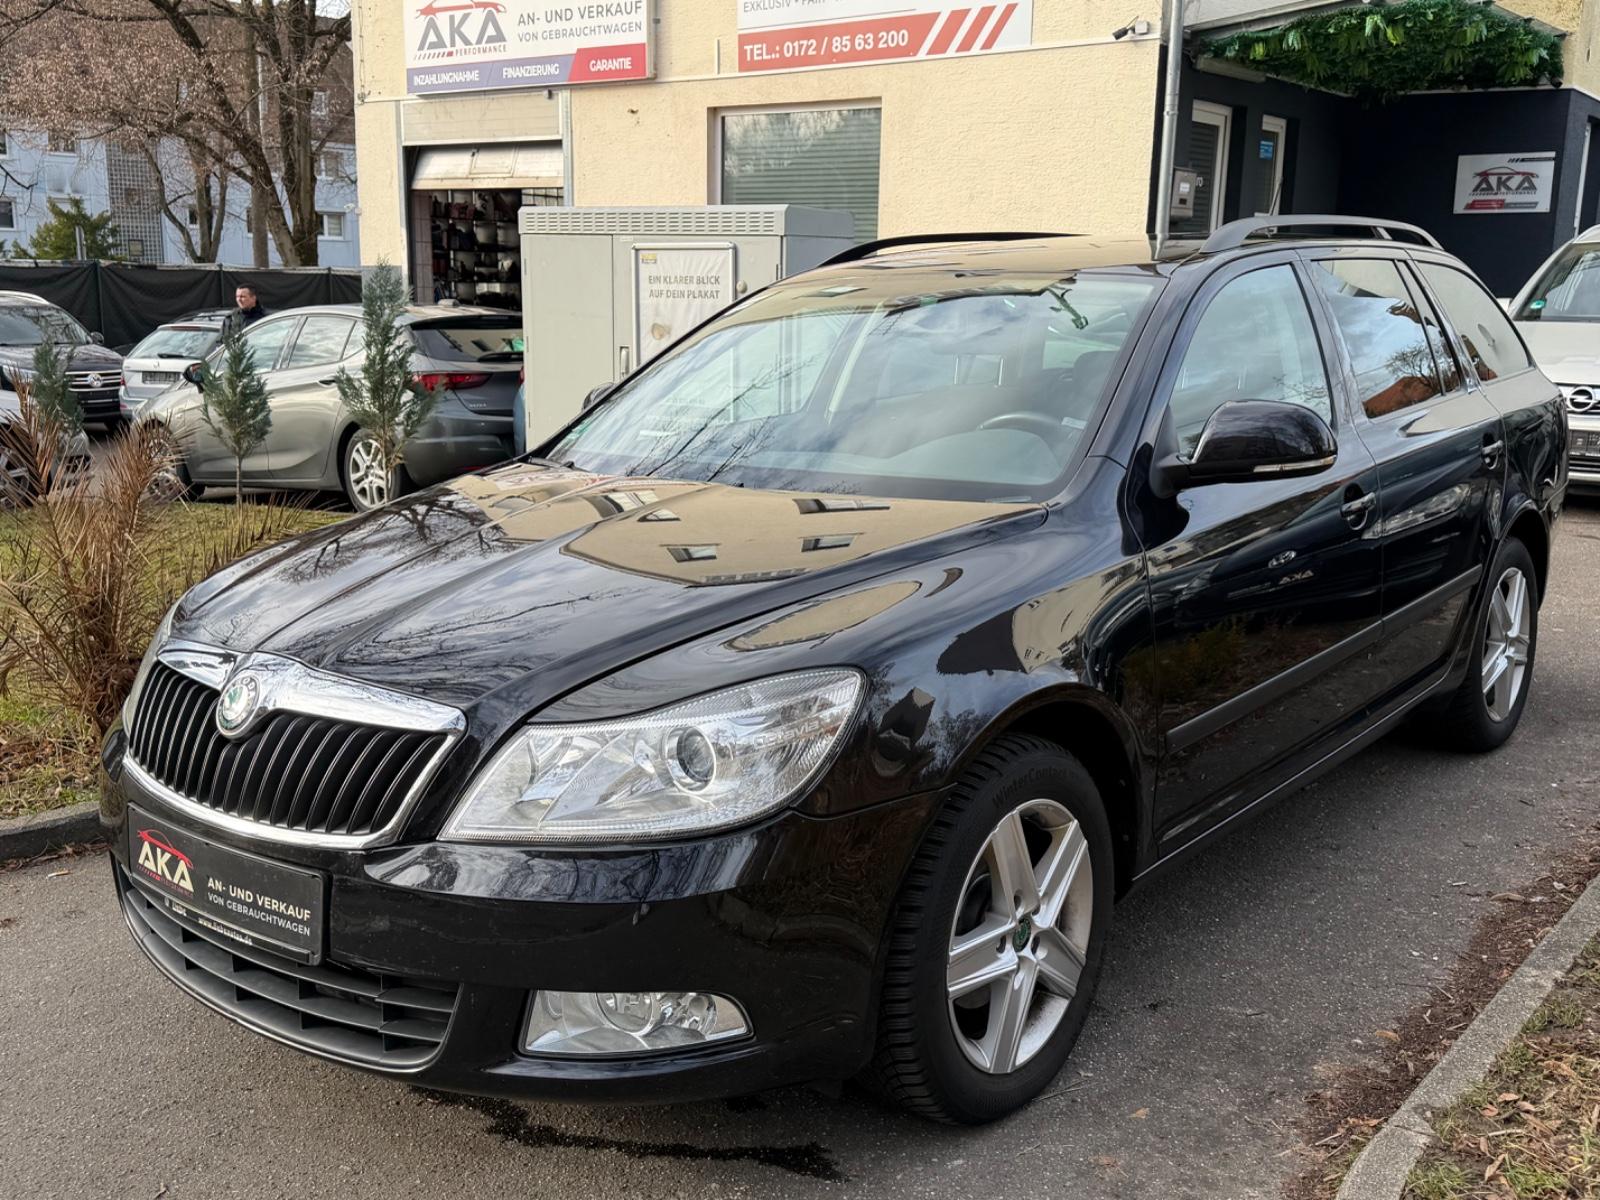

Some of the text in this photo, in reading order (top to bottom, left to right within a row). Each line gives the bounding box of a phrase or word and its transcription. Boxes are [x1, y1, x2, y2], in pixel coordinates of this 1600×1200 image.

[517, 0, 642, 26] AN- UND VERKAUF
[418, 10, 507, 51] AKA
[517, 21, 642, 42] VON GEBRAUCHTWAGEN
[455, 44, 507, 57] PERFORMANCE
[743, 44, 780, 62] TEL.:
[783, 38, 817, 58] 0172
[831, 34, 850, 53] 85
[854, 32, 873, 50] 63
[877, 29, 909, 49] 200
[502, 63, 560, 79] FINANZIERUNG
[589, 57, 633, 72] GARANTIE
[1472, 175, 1537, 192] AKA
[648, 275, 720, 285] EIN KLARER BLICK
[649, 289, 720, 299] AUF DEIN PLAKAT
[138, 841, 194, 893] AKA
[207, 877, 226, 891] AN-
[229, 885, 254, 903] UND
[256, 893, 311, 921] VERKAUF
[208, 892, 225, 906] VON
[226, 900, 310, 936] GEBRAUCHTWAGEN
